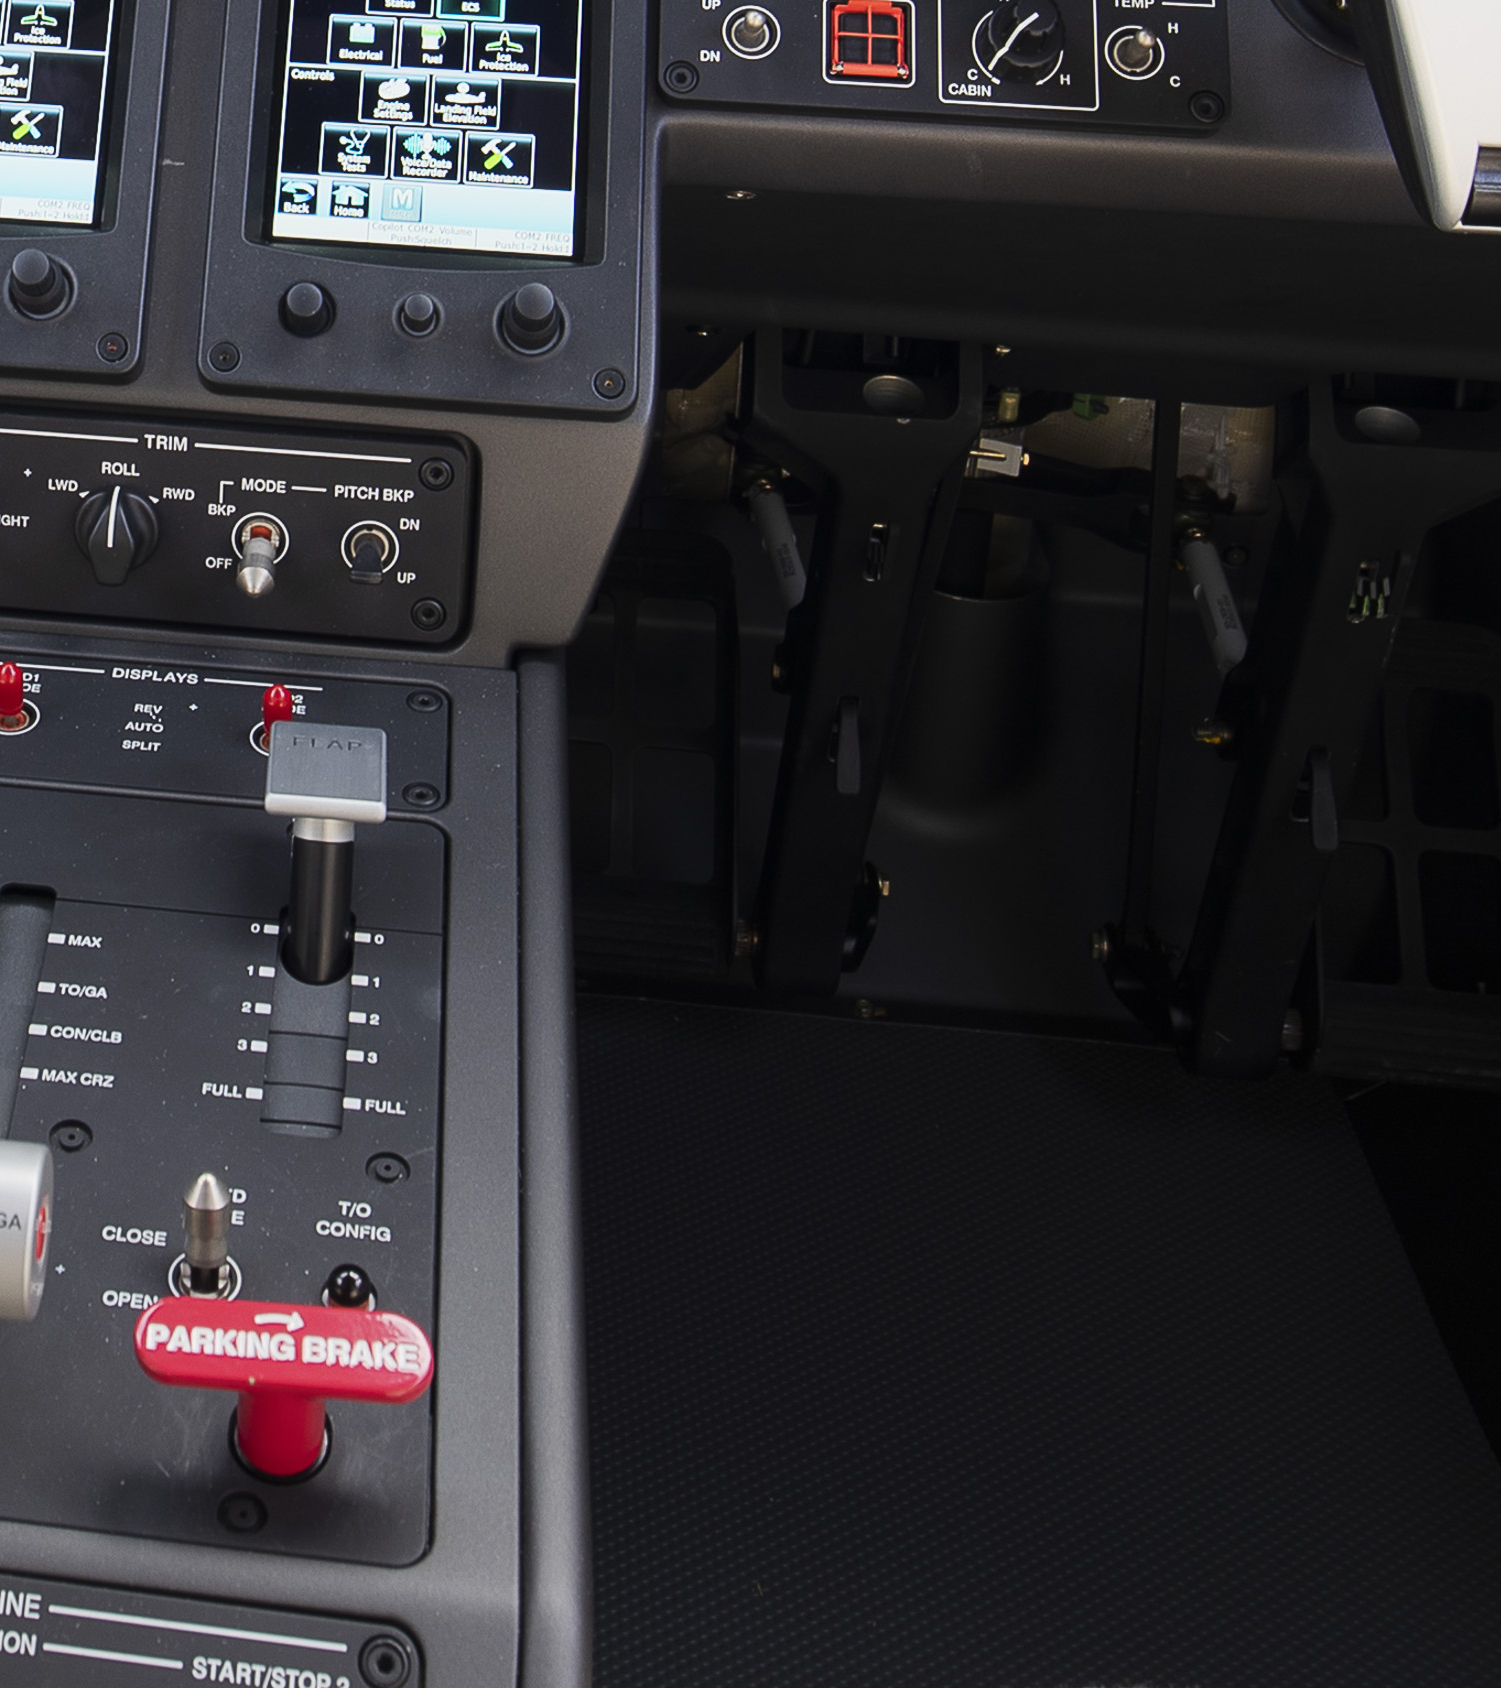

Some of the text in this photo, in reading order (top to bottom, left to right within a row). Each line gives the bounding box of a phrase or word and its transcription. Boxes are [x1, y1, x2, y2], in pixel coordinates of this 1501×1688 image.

[144, 434, 189, 452] TRIM
[334, 484, 414, 504] PITCH BKP
[112, 667, 198, 685] DISPLAYS
[122, 740, 161, 752] SPLIT
[293, 736, 362, 751] FLAP
[59, 983, 108, 999] TO/GA
[42, 1070, 114, 1088] MAX CRZ
[365, 1099, 406, 1115] FULL
[338, 1201, 372, 1218] T/O
[102, 1226, 167, 1246] CLOSE
[316, 1220, 391, 1242] CONFIG
[146, 1323, 420, 1372] PARKING BRAKE
